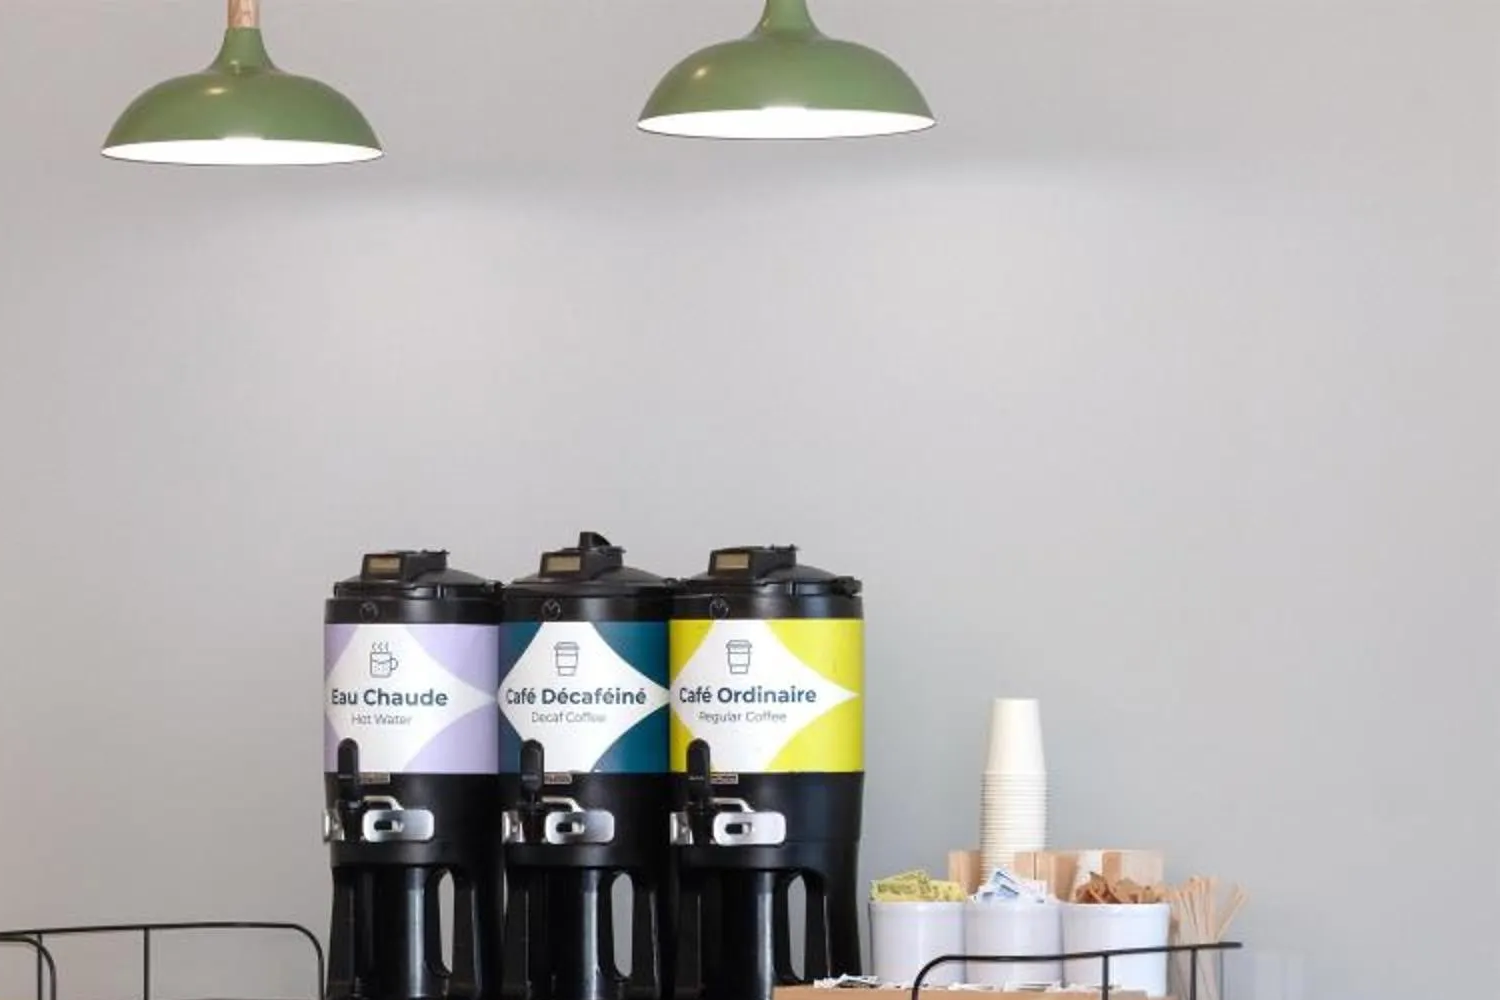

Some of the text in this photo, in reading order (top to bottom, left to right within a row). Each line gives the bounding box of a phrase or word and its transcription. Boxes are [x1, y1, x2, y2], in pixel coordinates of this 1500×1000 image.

[331, 688, 449, 706] Eau Chaude
[506, 687, 647, 705] Café Décaféiné
[679, 685, 817, 704] Café Ordinaire
[352, 713, 412, 725] Hot Water
[531, 711, 564, 723] Decaf
[699, 711, 787, 725] Regular Coffee
